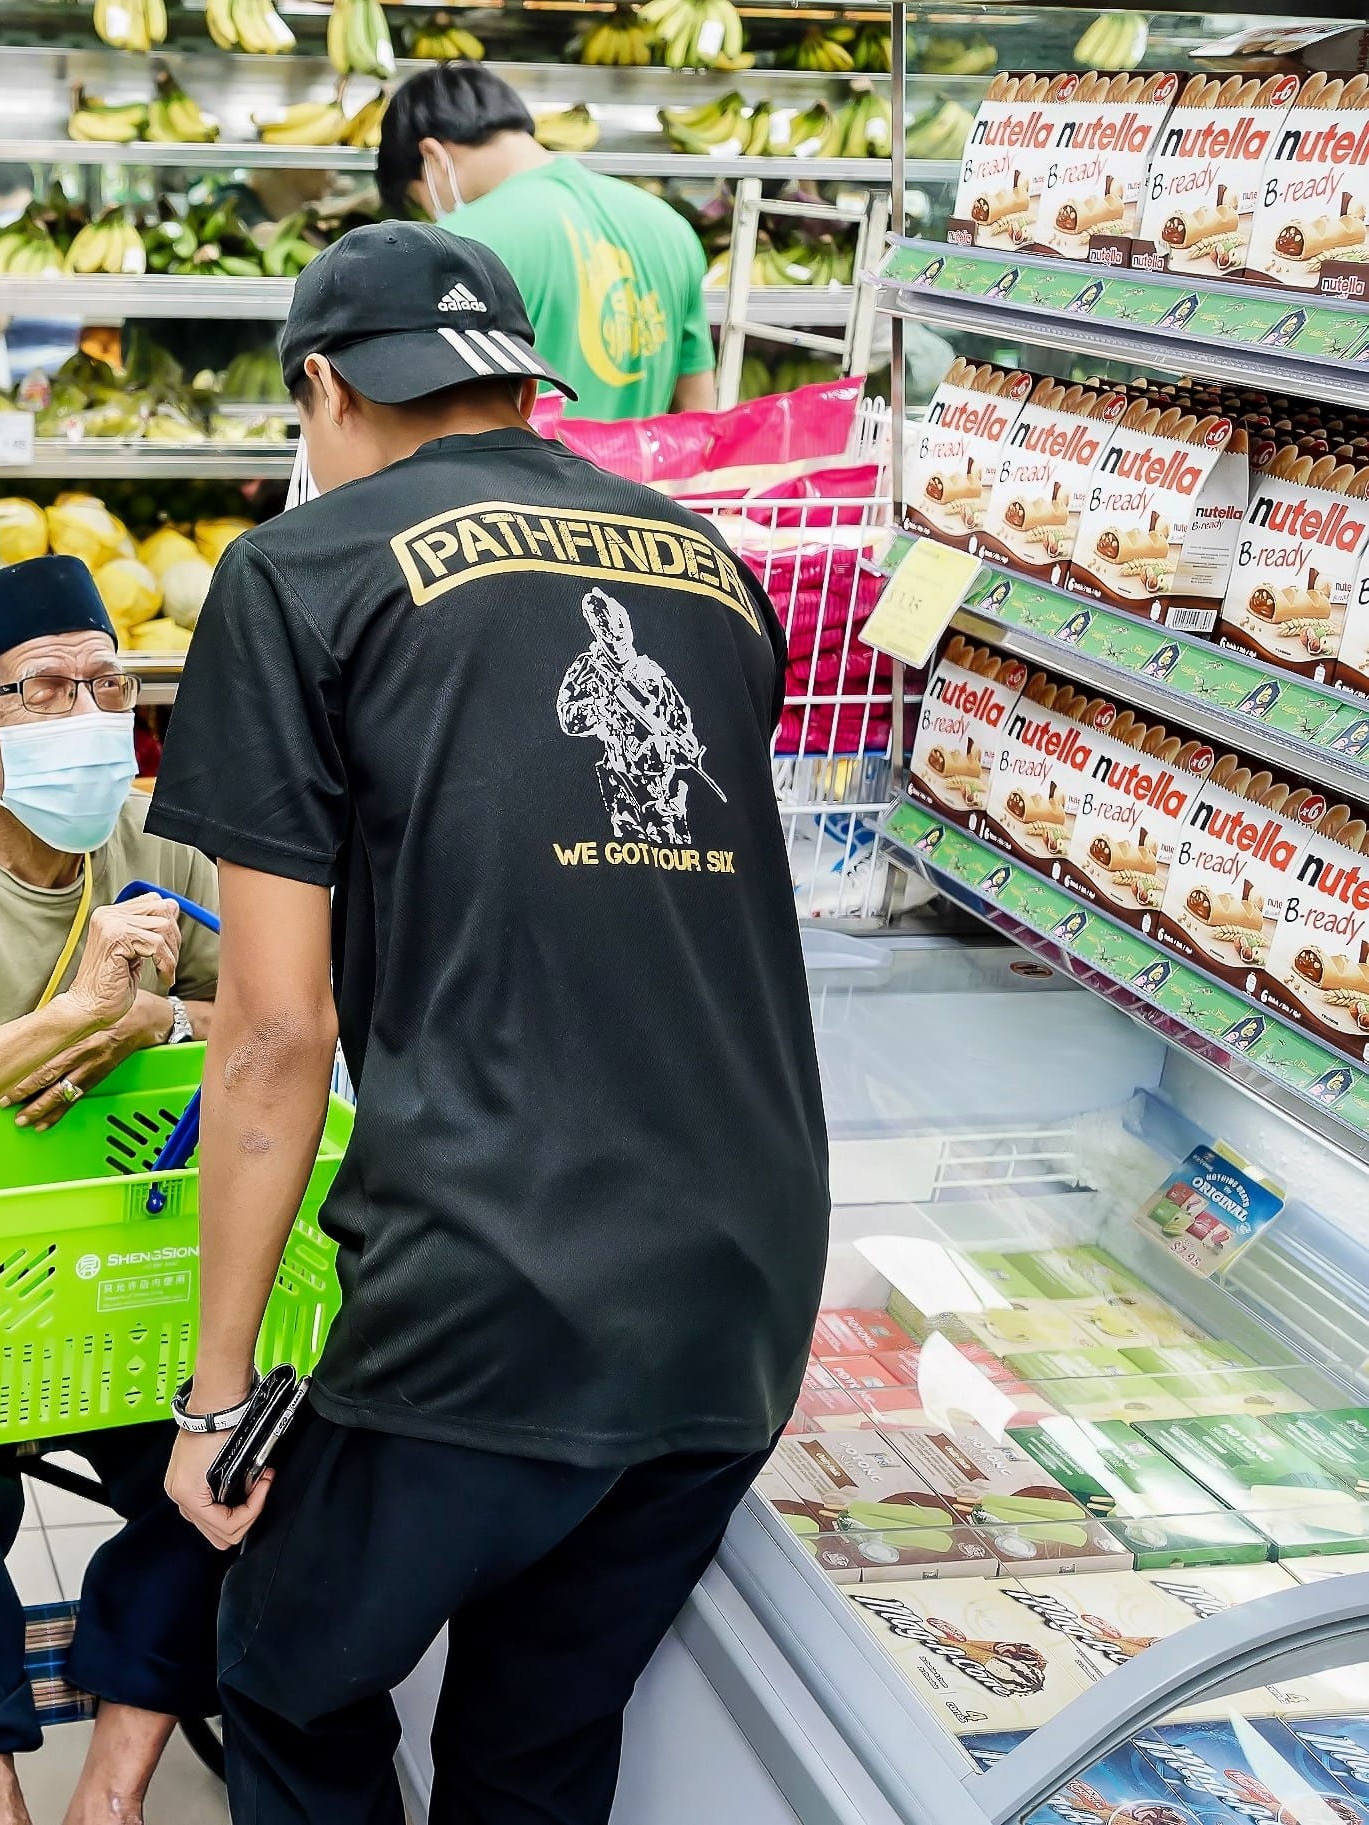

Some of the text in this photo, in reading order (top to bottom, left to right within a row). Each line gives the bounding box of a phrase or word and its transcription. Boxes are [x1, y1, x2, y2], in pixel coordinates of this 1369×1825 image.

[971, 111, 1055, 148] nutella
[1056, 113, 1152, 152] nutella
[1161, 117, 1271, 160] nutella
[964, 151, 1015, 183] B-ready
[1047, 154, 1108, 188] B-ready
[1151, 162, 1220, 200] B-ready
[1264, 167, 1345, 207] B-ready
[1321, 275, 1366, 295] nutella
[438, 300, 488, 313] adidas
[929, 401, 1008, 443] nutella
[919, 436, 969, 461] B-ready
[1011, 421, 1100, 467] nutella
[1000, 457, 1057, 488] B-ready
[1100, 446, 1202, 496] nutella
[1089, 486, 1155, 519] B-ready
[1195, 506, 1243, 520] nutella
[1249, 495, 1367, 554] nutella
[413, 513, 749, 612] PATHFINDER
[1238, 540, 1313, 577] B-ready
[930, 674, 1005, 728] nutella
[921, 709, 970, 742] B-ready
[1008, 713, 1093, 772] nutella
[999, 750, 1054, 785] B-ready
[1190, 748, 1214, 771] x6
[1092, 752, 1188, 819] nutella
[1082, 793, 1144, 833] B-ready
[1299, 797, 1325, 823] x6
[1190, 798, 1298, 873] nutella
[553, 842, 735, 874] WE GOT YOUR SIX
[1179, 841, 1247, 885] B-ready
[1284, 897, 1365, 946] B-ready
[1191, 1175, 1249, 1222] ORIGINAL
[965, 1710, 988, 1723] 4
